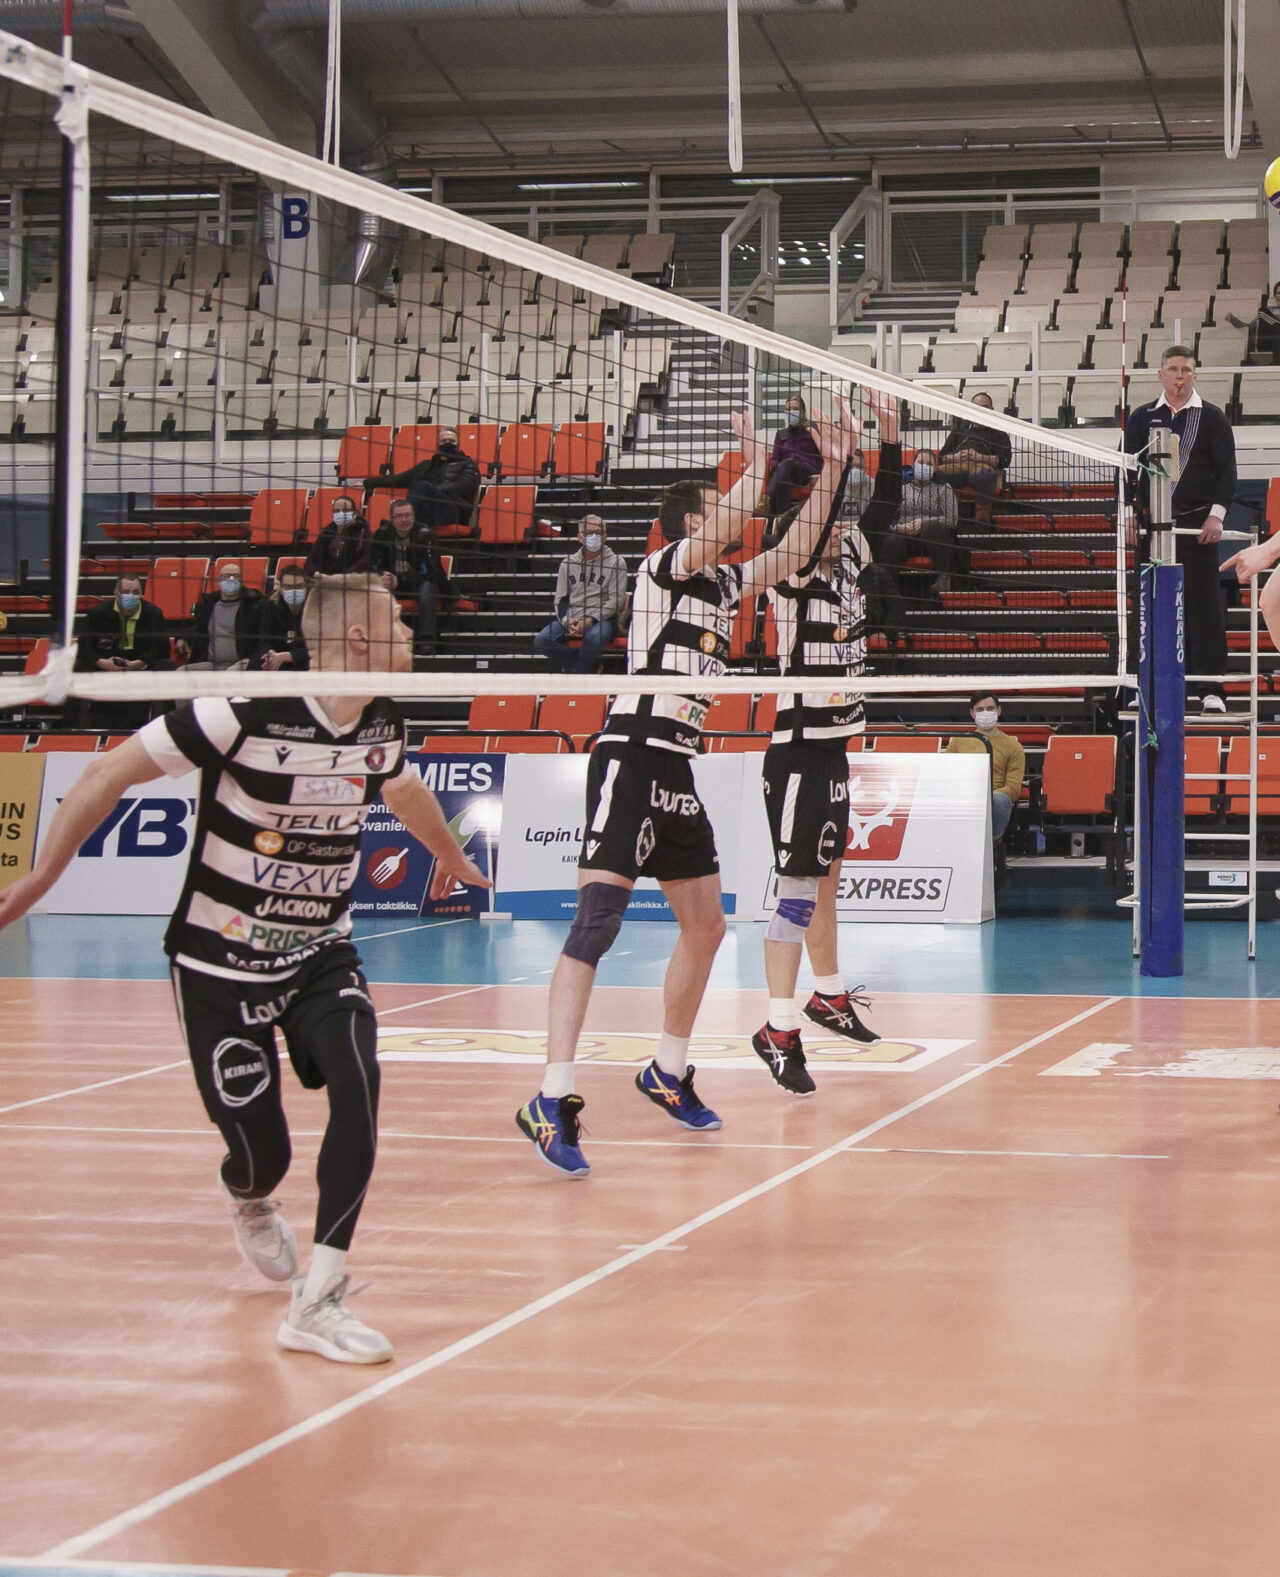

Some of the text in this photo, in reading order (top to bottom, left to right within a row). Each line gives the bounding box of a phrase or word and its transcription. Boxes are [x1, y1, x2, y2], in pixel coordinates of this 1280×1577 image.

[283, 198, 310, 239] B
[330, 751, 341, 769] 7
[525, 827, 571, 846] Lapin
[252, 856, 350, 894] VEXVE
[255, 895, 332, 919] JACKON
